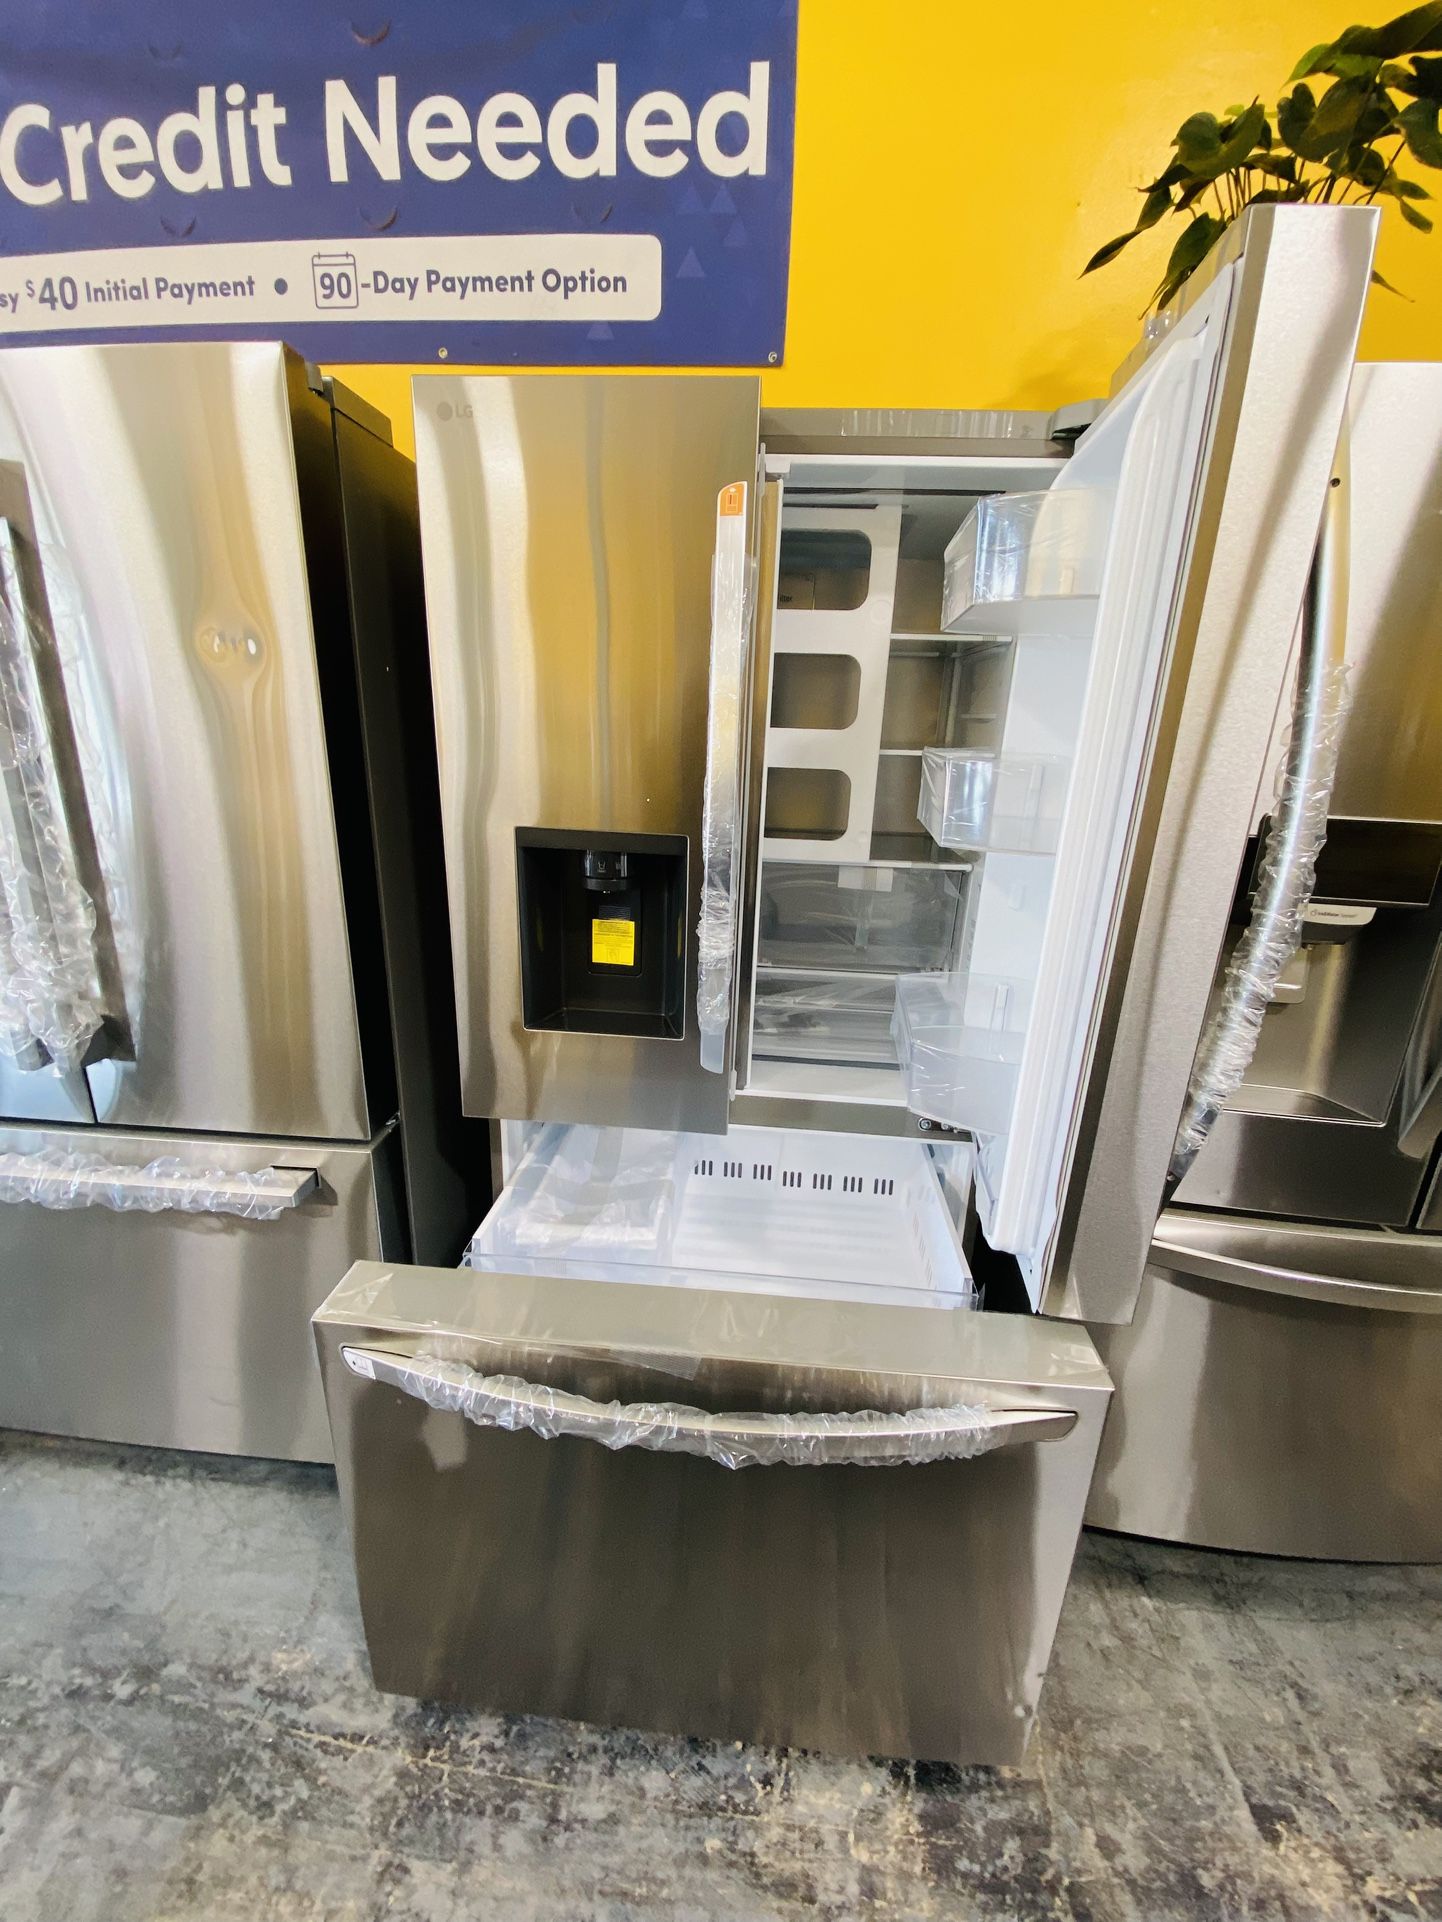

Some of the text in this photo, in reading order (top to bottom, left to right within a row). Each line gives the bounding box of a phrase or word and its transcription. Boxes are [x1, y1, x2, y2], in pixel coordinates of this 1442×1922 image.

[0, 60, 770, 205] Credit Needed
[26, 275, 79, 311] $40
[85, 276, 149, 303] Initial
[155, 275, 255, 305] Payment
[426, 269, 535, 301] Payment
[542, 268, 628, 301] Option
[456, 403, 474, 418] LG
